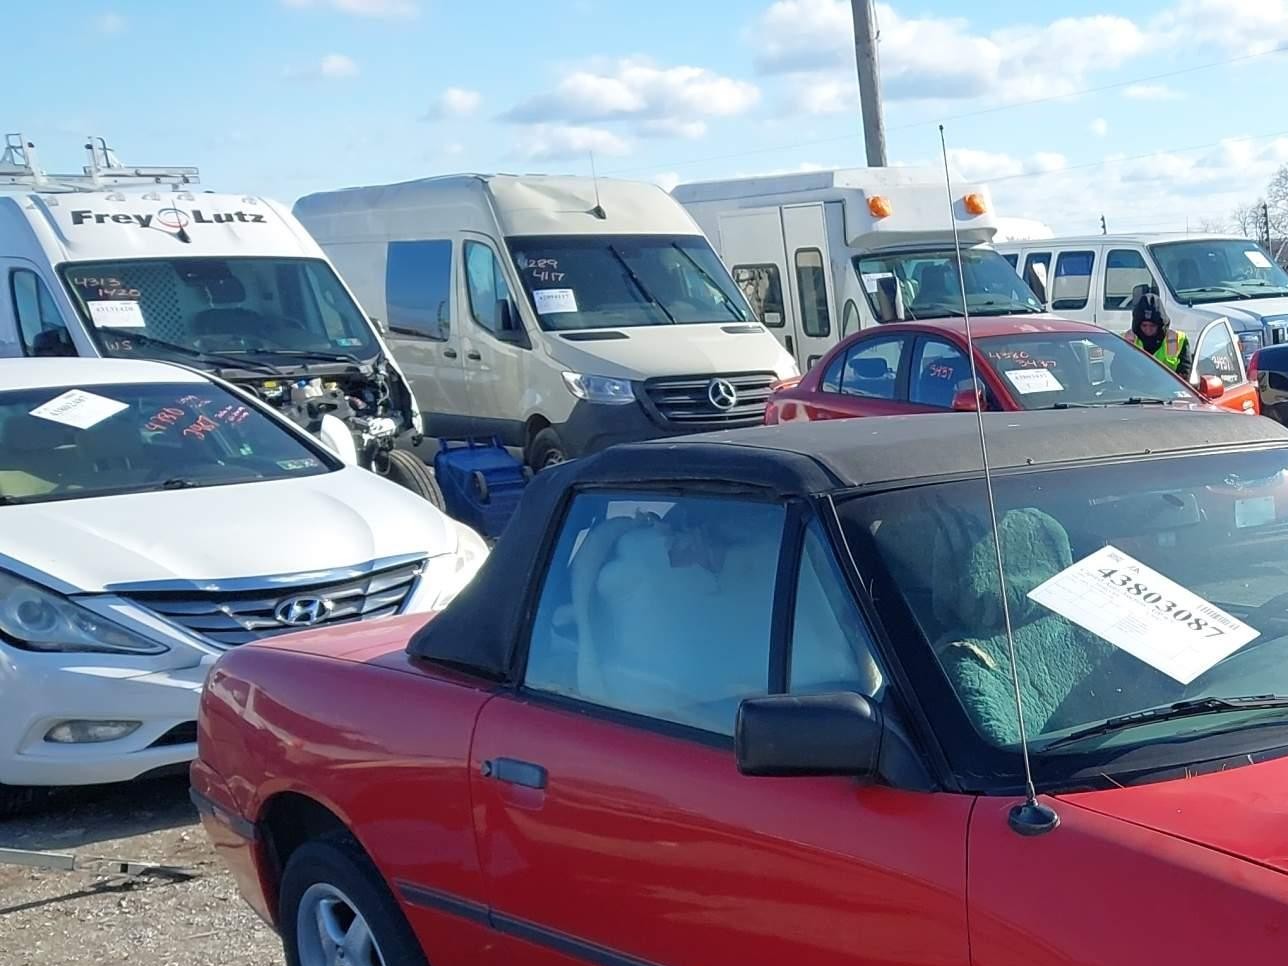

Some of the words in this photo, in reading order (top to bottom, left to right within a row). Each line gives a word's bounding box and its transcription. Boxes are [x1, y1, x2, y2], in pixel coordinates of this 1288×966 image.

[71, 209, 153, 228] Frey
[191, 209, 267, 224] Lutz
[98, 288, 141, 298] 1420
[1097, 566, 1226, 639] 43803087
